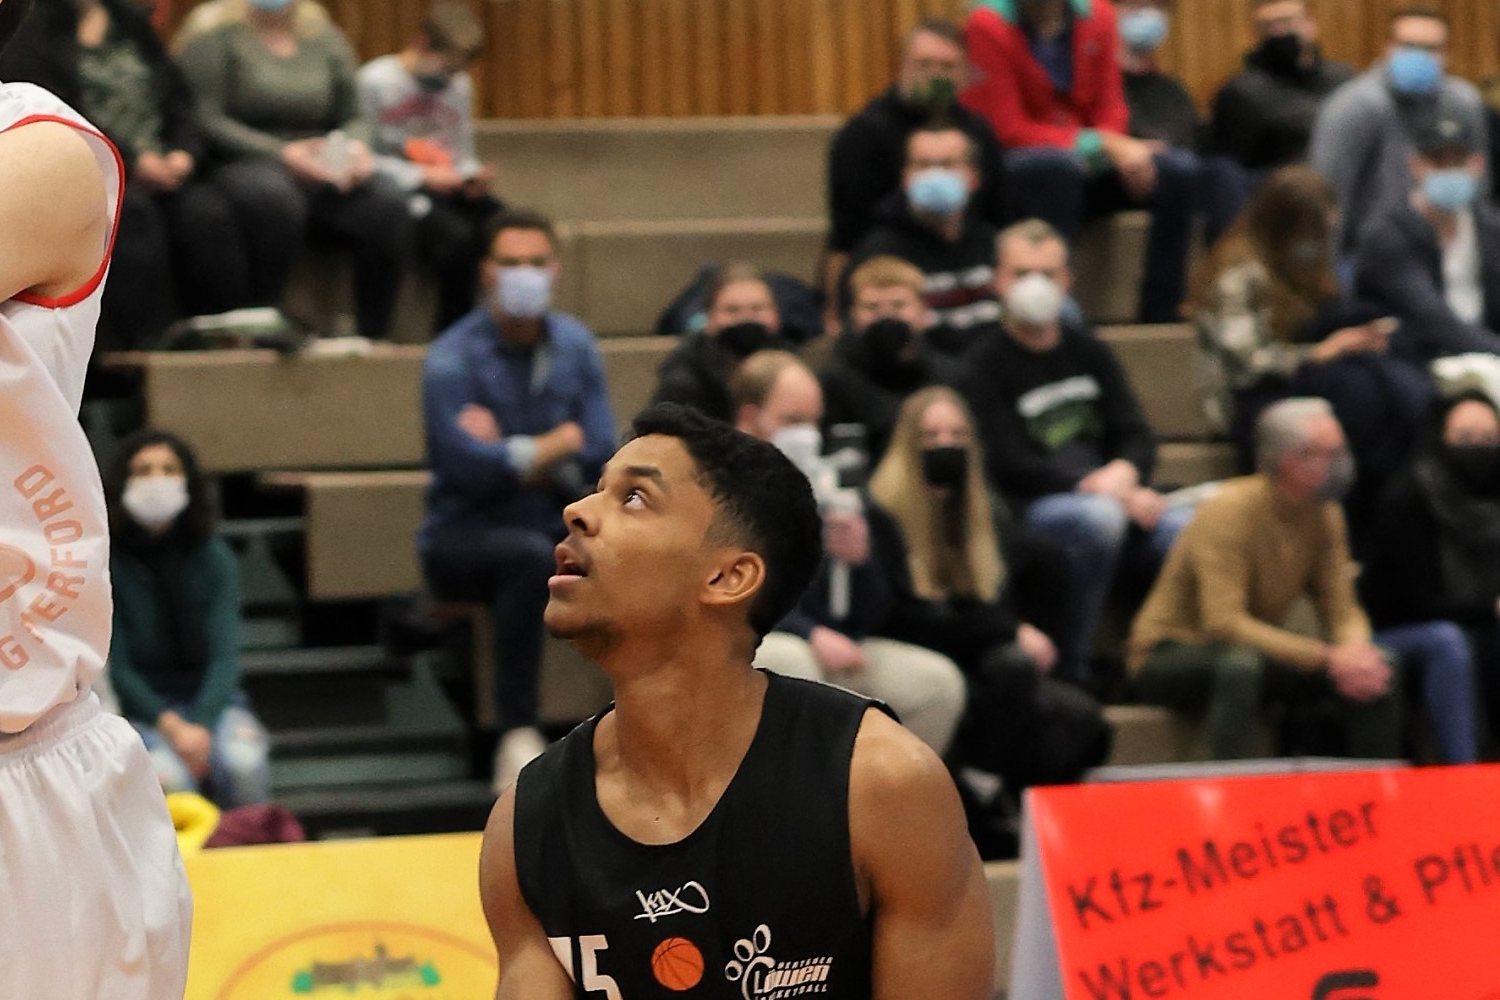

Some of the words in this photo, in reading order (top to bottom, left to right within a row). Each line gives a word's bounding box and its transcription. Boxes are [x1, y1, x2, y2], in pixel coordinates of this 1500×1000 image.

[1067, 801, 1378, 929] Kfz-Meister
[1079, 894, 1350, 1000] Werkstatt
[1362, 874, 1402, 925] &
